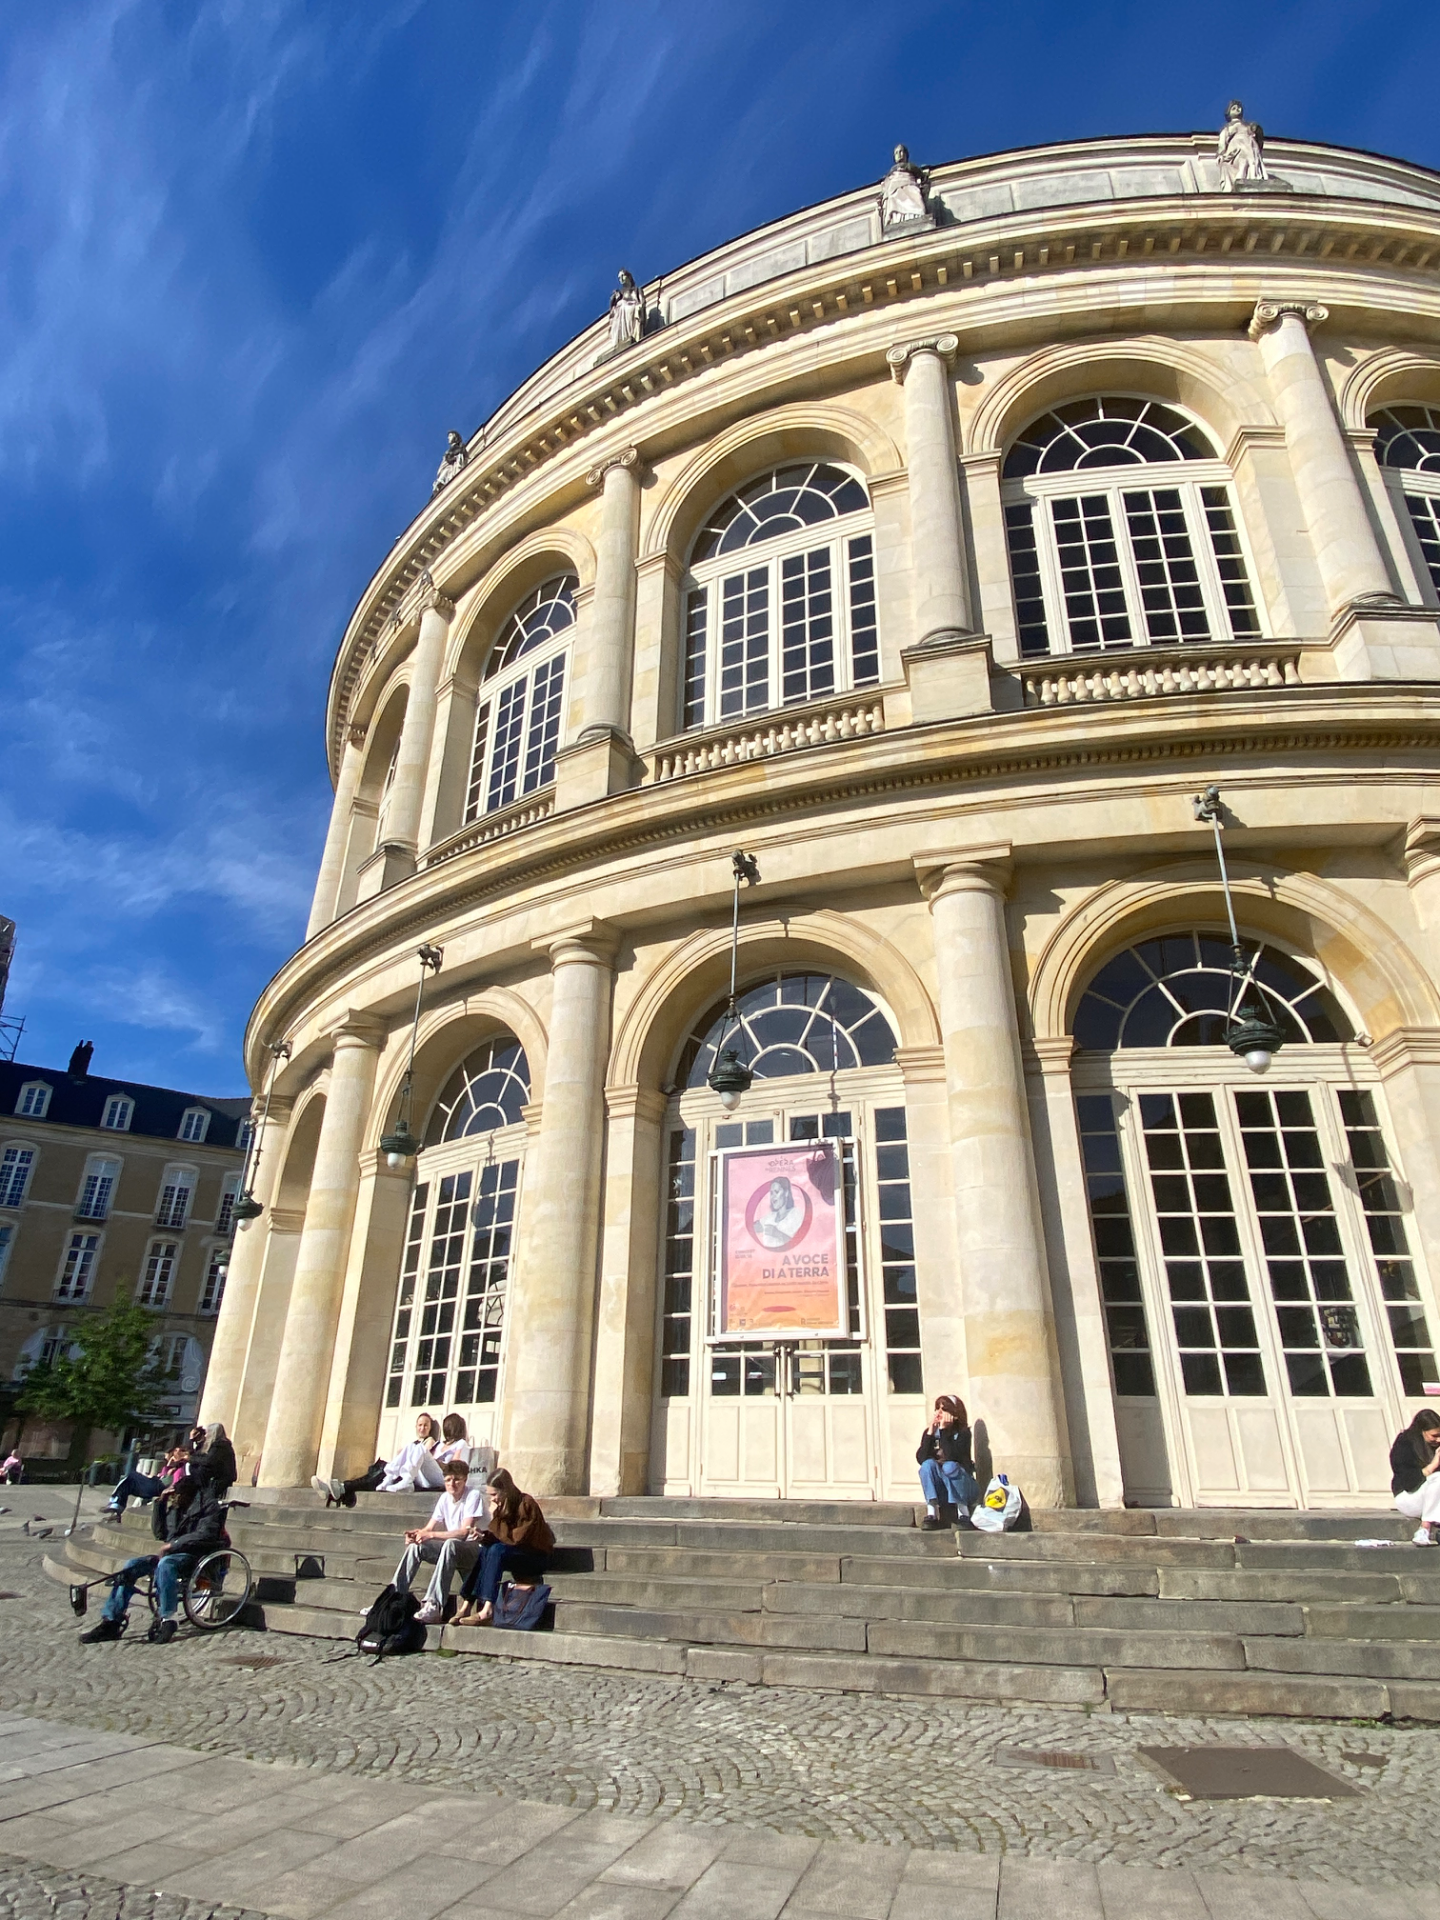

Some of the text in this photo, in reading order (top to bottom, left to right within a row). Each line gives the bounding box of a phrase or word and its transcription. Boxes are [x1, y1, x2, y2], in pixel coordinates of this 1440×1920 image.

[782, 1253, 829, 1266] A VOCE
[762, 1266, 829, 1279] DI A TERRA
[469, 1466, 488, 1474] HKA
